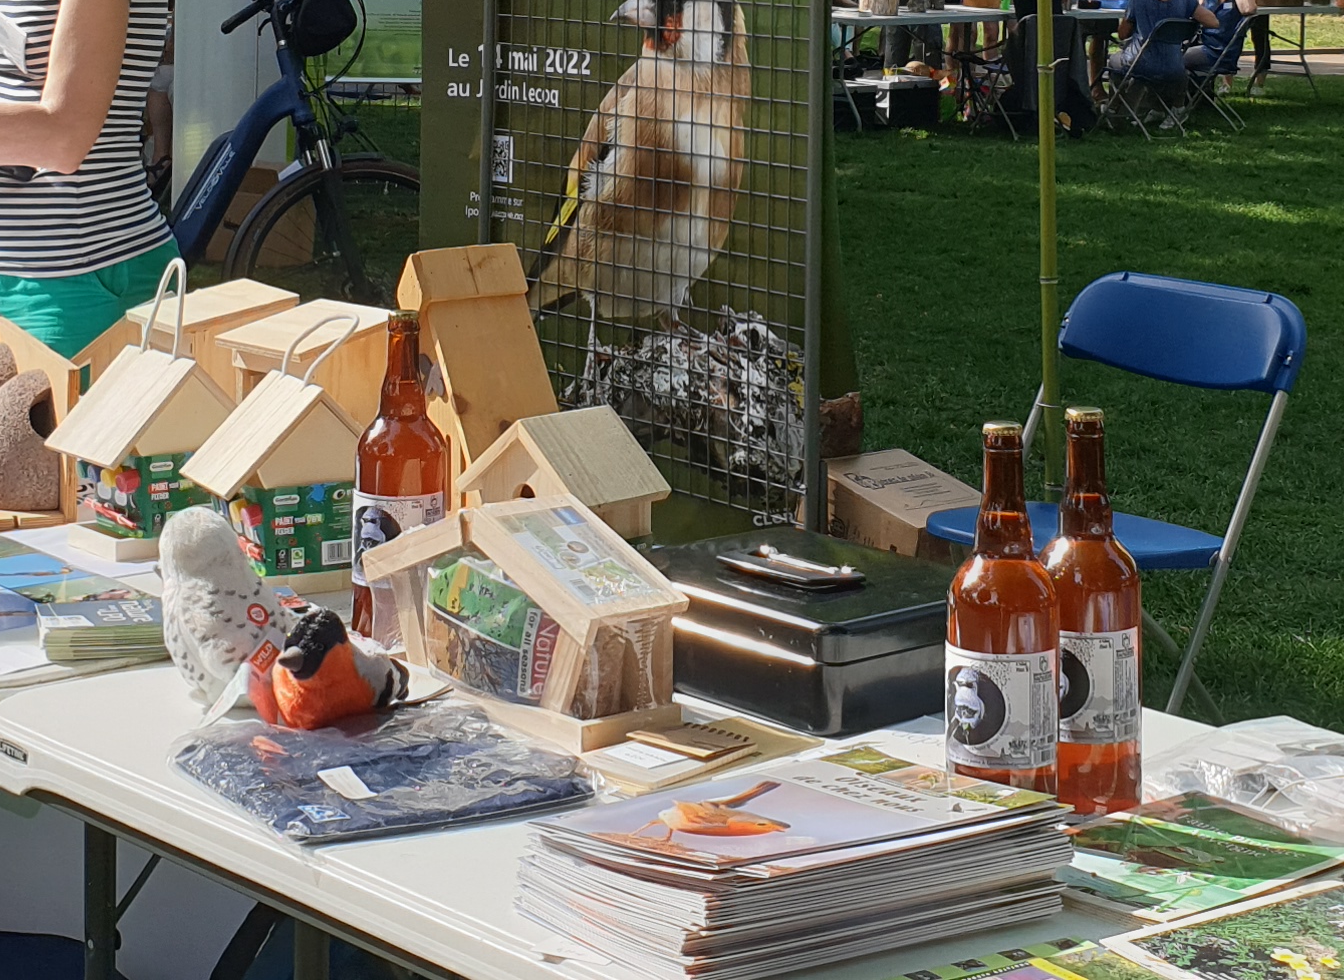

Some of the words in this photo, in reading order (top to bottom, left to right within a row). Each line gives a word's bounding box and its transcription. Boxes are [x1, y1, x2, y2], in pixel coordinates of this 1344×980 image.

[448, 48, 470, 67] Le
[509, 47, 538, 72] mai
[545, 49, 591, 75] 2022
[447, 82, 470, 97] au
[476, 79, 519, 101] Jrdin
[528, 610, 539, 629] for
[524, 631, 533, 647] all
[253, 643, 274, 665] WILD
[532, 614, 558, 696] Nature
[519, 649, 529, 694] seasons
[792, 775, 822, 785] de
[821, 783, 870, 800] chez
[870, 798, 926, 814] nous
[835, 776, 929, 804] Oiseaux
